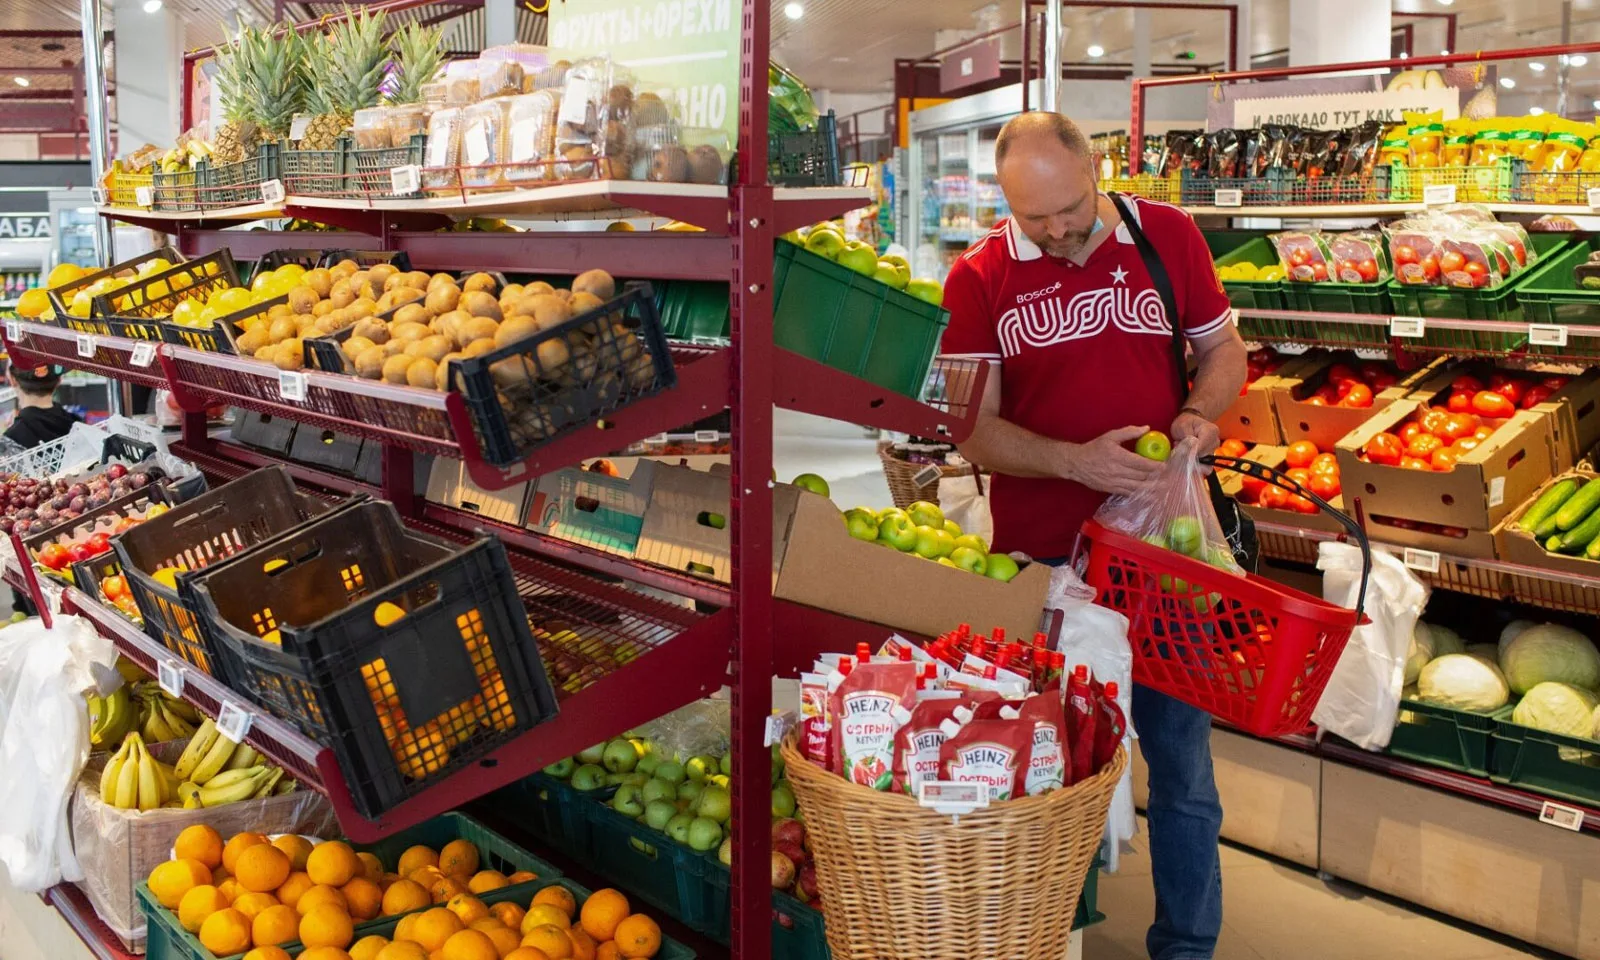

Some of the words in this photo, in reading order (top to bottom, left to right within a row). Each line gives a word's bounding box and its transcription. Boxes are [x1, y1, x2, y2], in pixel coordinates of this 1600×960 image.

[1334, 110, 1361, 125] ТУТ
[1366, 108, 1395, 122] КАК
[917, 733, 948, 750] HEIN
[1032, 729, 1055, 746] EINZ
[964, 749, 1006, 766] HEINZ
